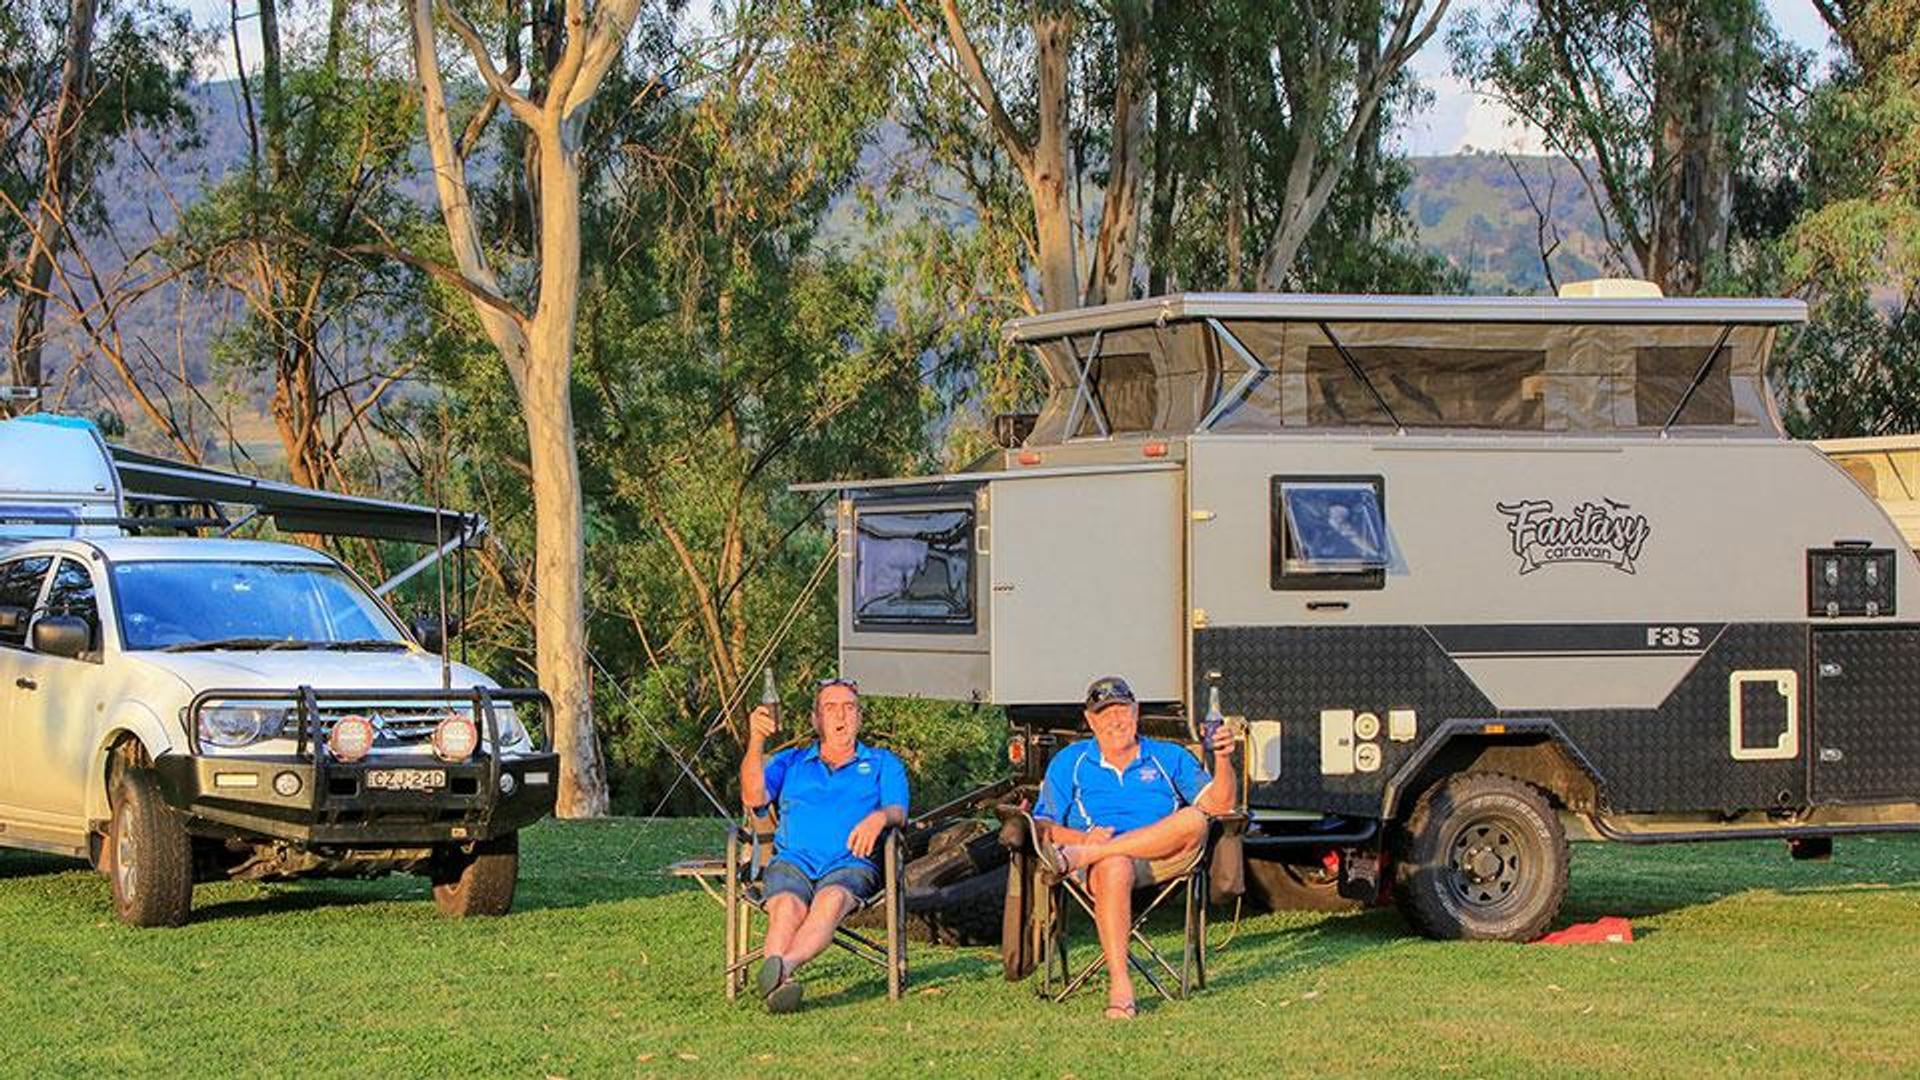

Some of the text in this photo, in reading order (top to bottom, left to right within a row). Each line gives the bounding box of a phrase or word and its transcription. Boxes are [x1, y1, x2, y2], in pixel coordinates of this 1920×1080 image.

[1497, 500, 1650, 560] Fantasy
[1545, 546, 1611, 559] caravan
[1647, 626, 1701, 646] F3S
